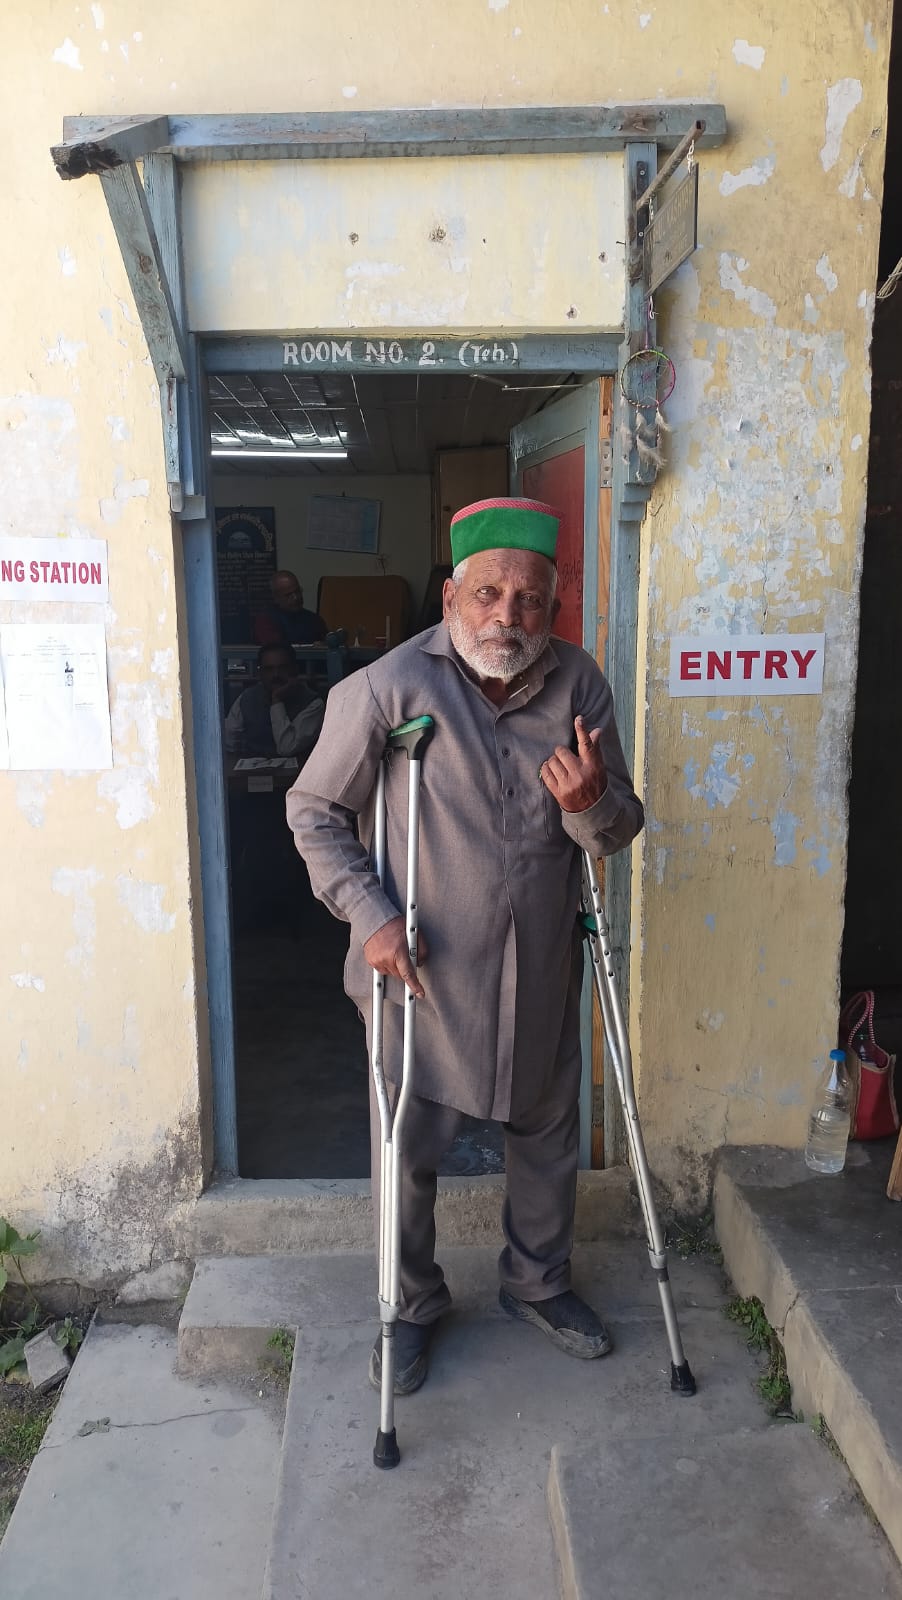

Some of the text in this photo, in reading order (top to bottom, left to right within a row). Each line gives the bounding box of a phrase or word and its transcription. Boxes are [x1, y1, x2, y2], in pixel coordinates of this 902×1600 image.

[282, 340, 518, 368] ROOM NO. 2. (Teh.)
[29, 560, 102, 585] STATION
[680, 649, 817, 681] ENTRY
